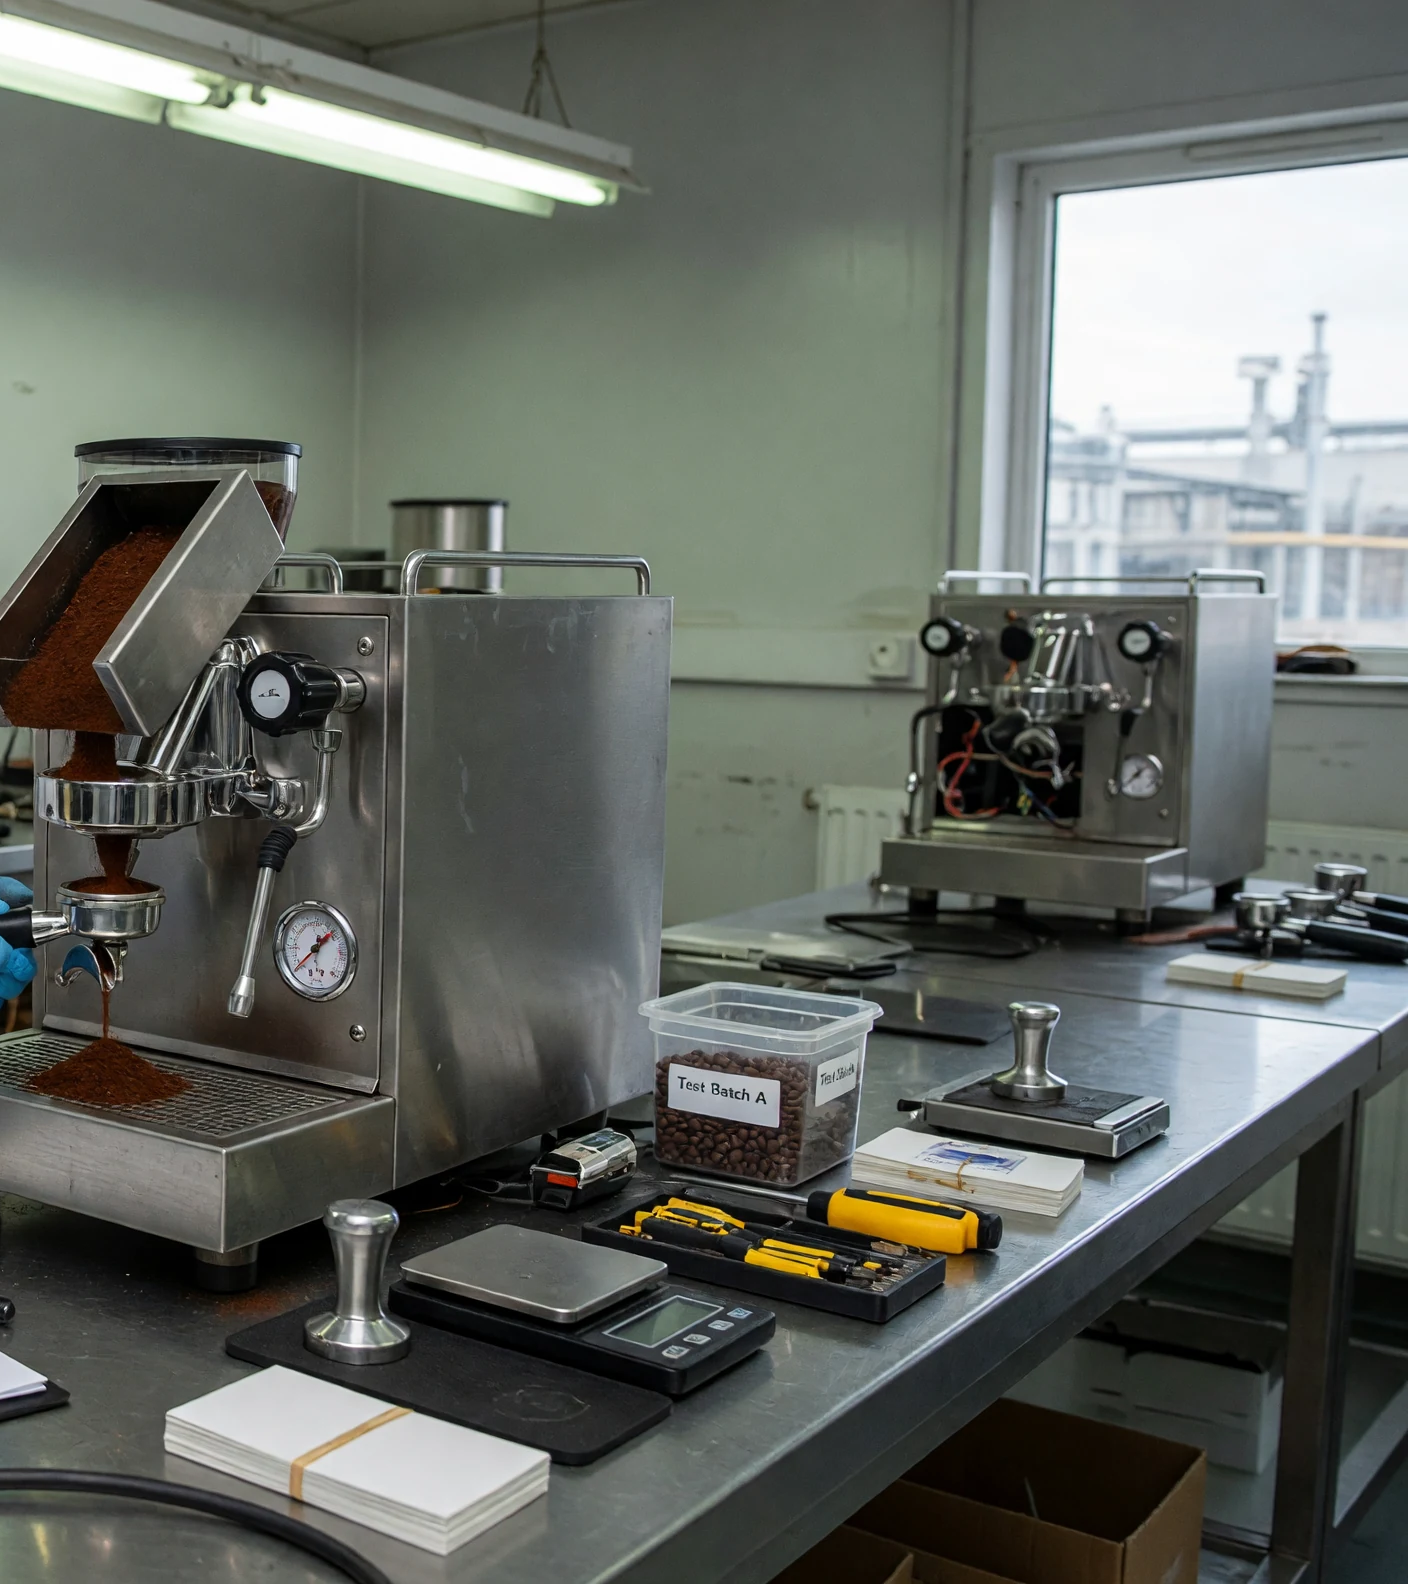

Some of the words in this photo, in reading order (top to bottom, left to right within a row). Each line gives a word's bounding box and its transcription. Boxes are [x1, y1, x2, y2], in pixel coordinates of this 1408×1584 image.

[677, 1076, 705, 1093] Test
[711, 1083, 750, 1102] Batch
[755, 1092, 767, 1105] A
